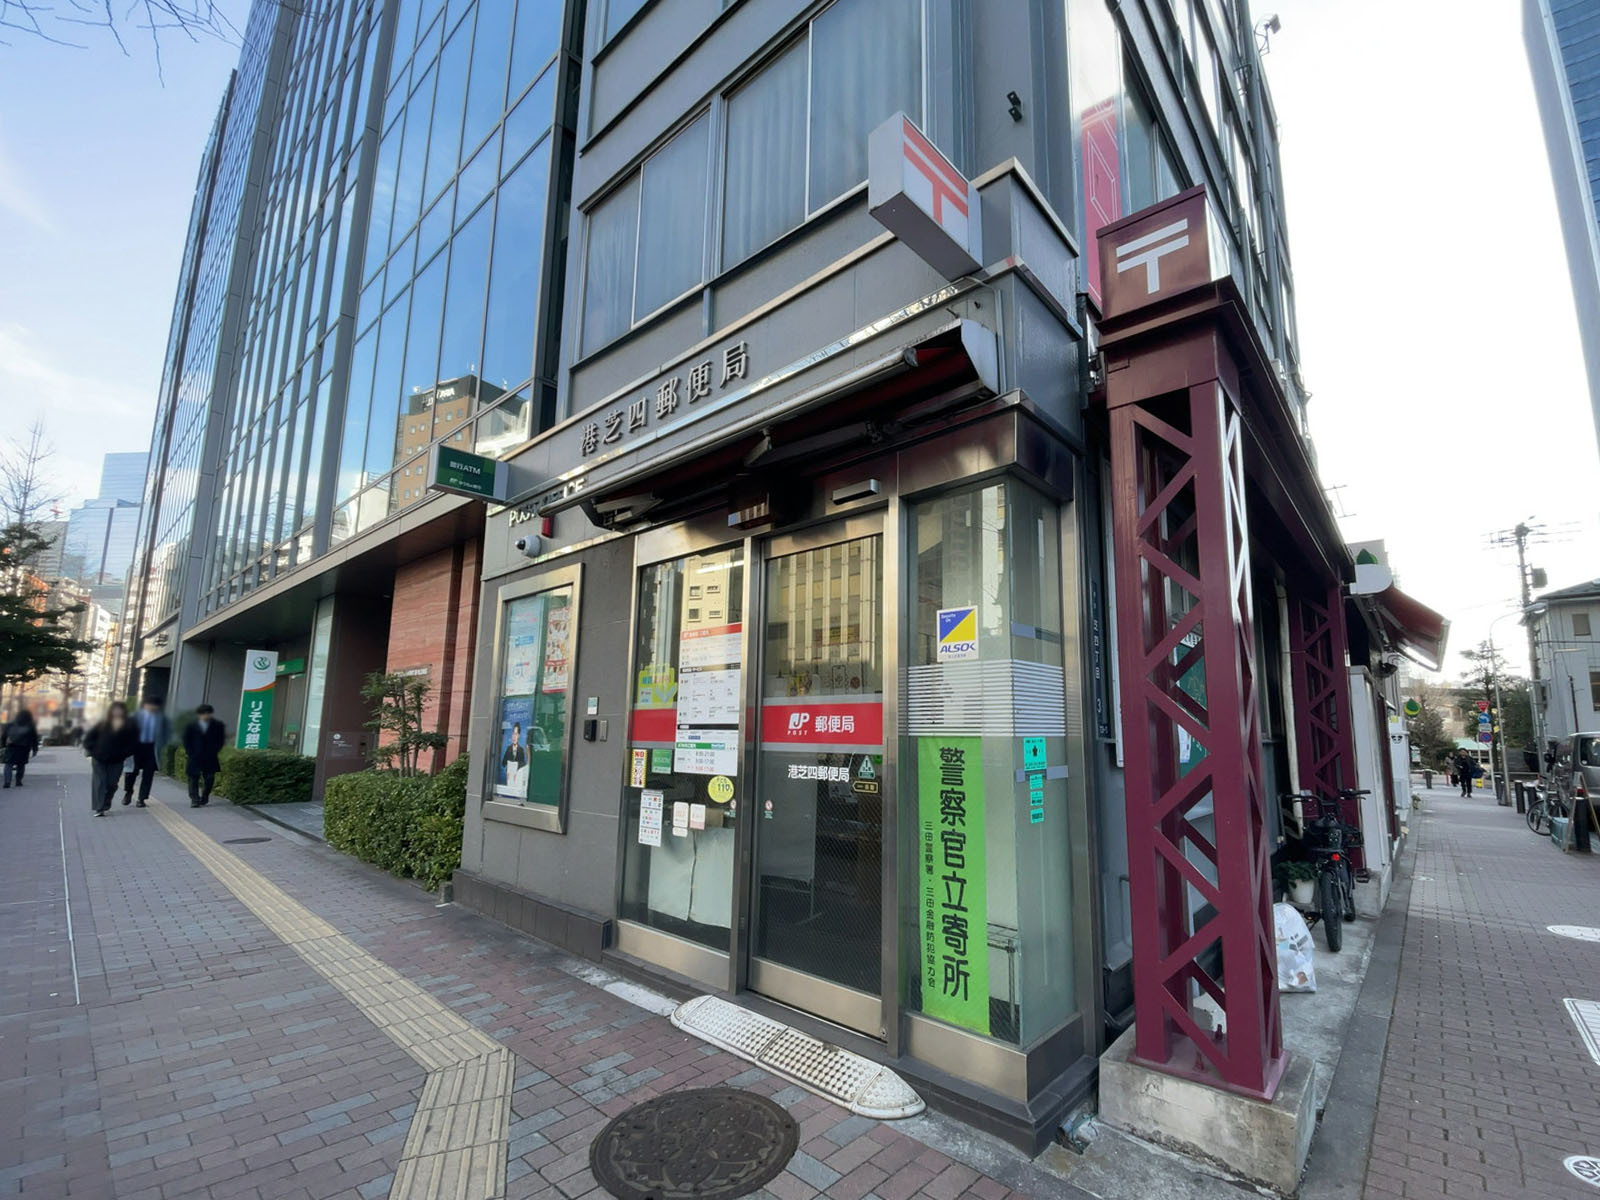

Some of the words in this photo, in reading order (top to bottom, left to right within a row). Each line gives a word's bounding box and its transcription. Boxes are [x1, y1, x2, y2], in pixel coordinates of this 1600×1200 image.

[581, 340, 750, 457] 港芝四郵便局
[940, 642, 976, 653] ALSOK
[815, 715, 855, 733] 郵便局
[788, 765, 850, 782] 港芝四郵便局
[938, 747, 969, 1002] 警察官立寄所
